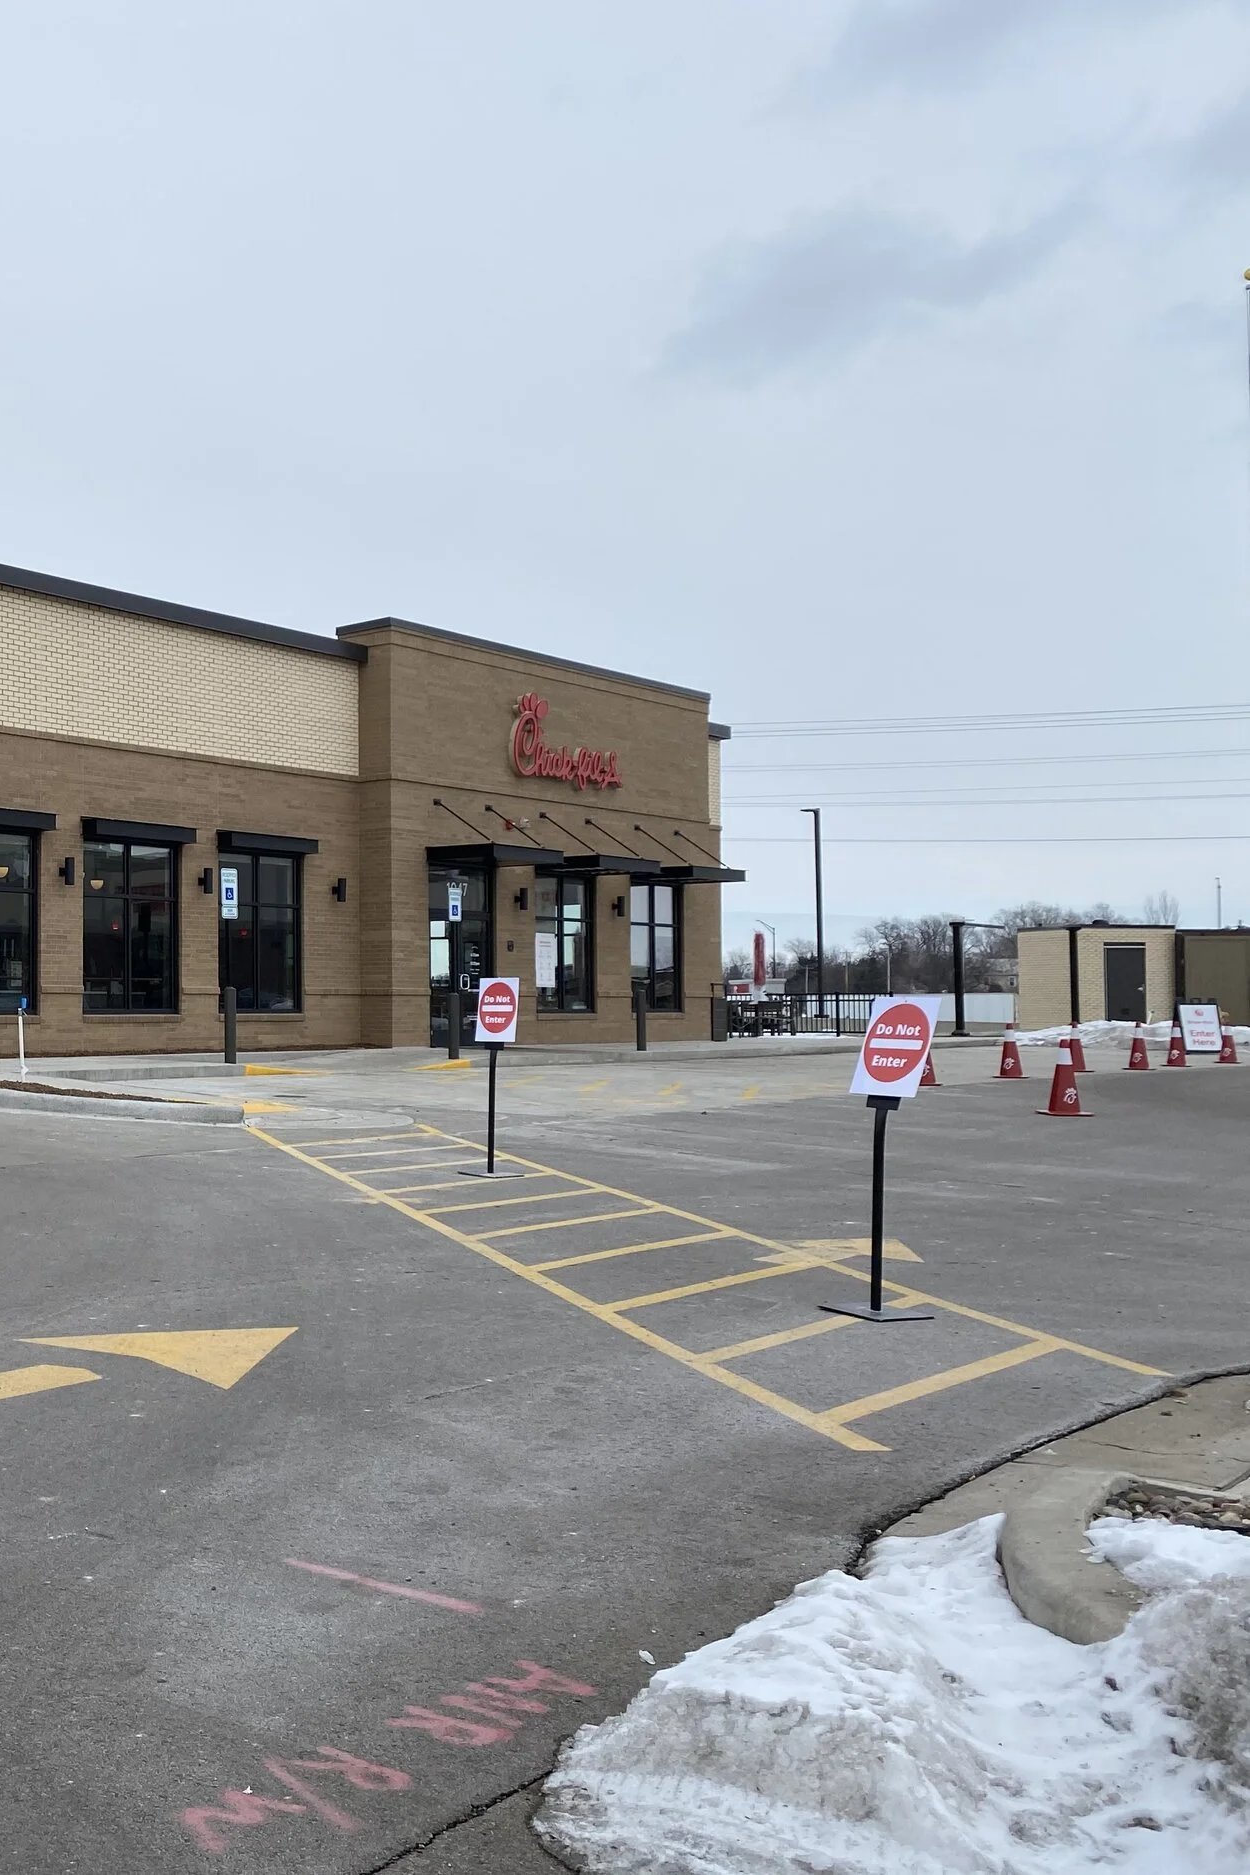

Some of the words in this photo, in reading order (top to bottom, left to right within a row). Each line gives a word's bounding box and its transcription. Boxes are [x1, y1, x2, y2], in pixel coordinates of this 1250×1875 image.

[511, 692, 622, 790] Chick-fil-A
[484, 995, 494, 1003] Do
[496, 995, 510, 1003] Not
[485, 1015, 506, 1023] Enter
[876, 1023, 893, 1035] Do
[895, 1024, 921, 1036] Not
[1190, 1029, 1215, 1037] Enter
[1192, 1038, 1216, 1046] Here
[871, 1055, 907, 1067] Enter
